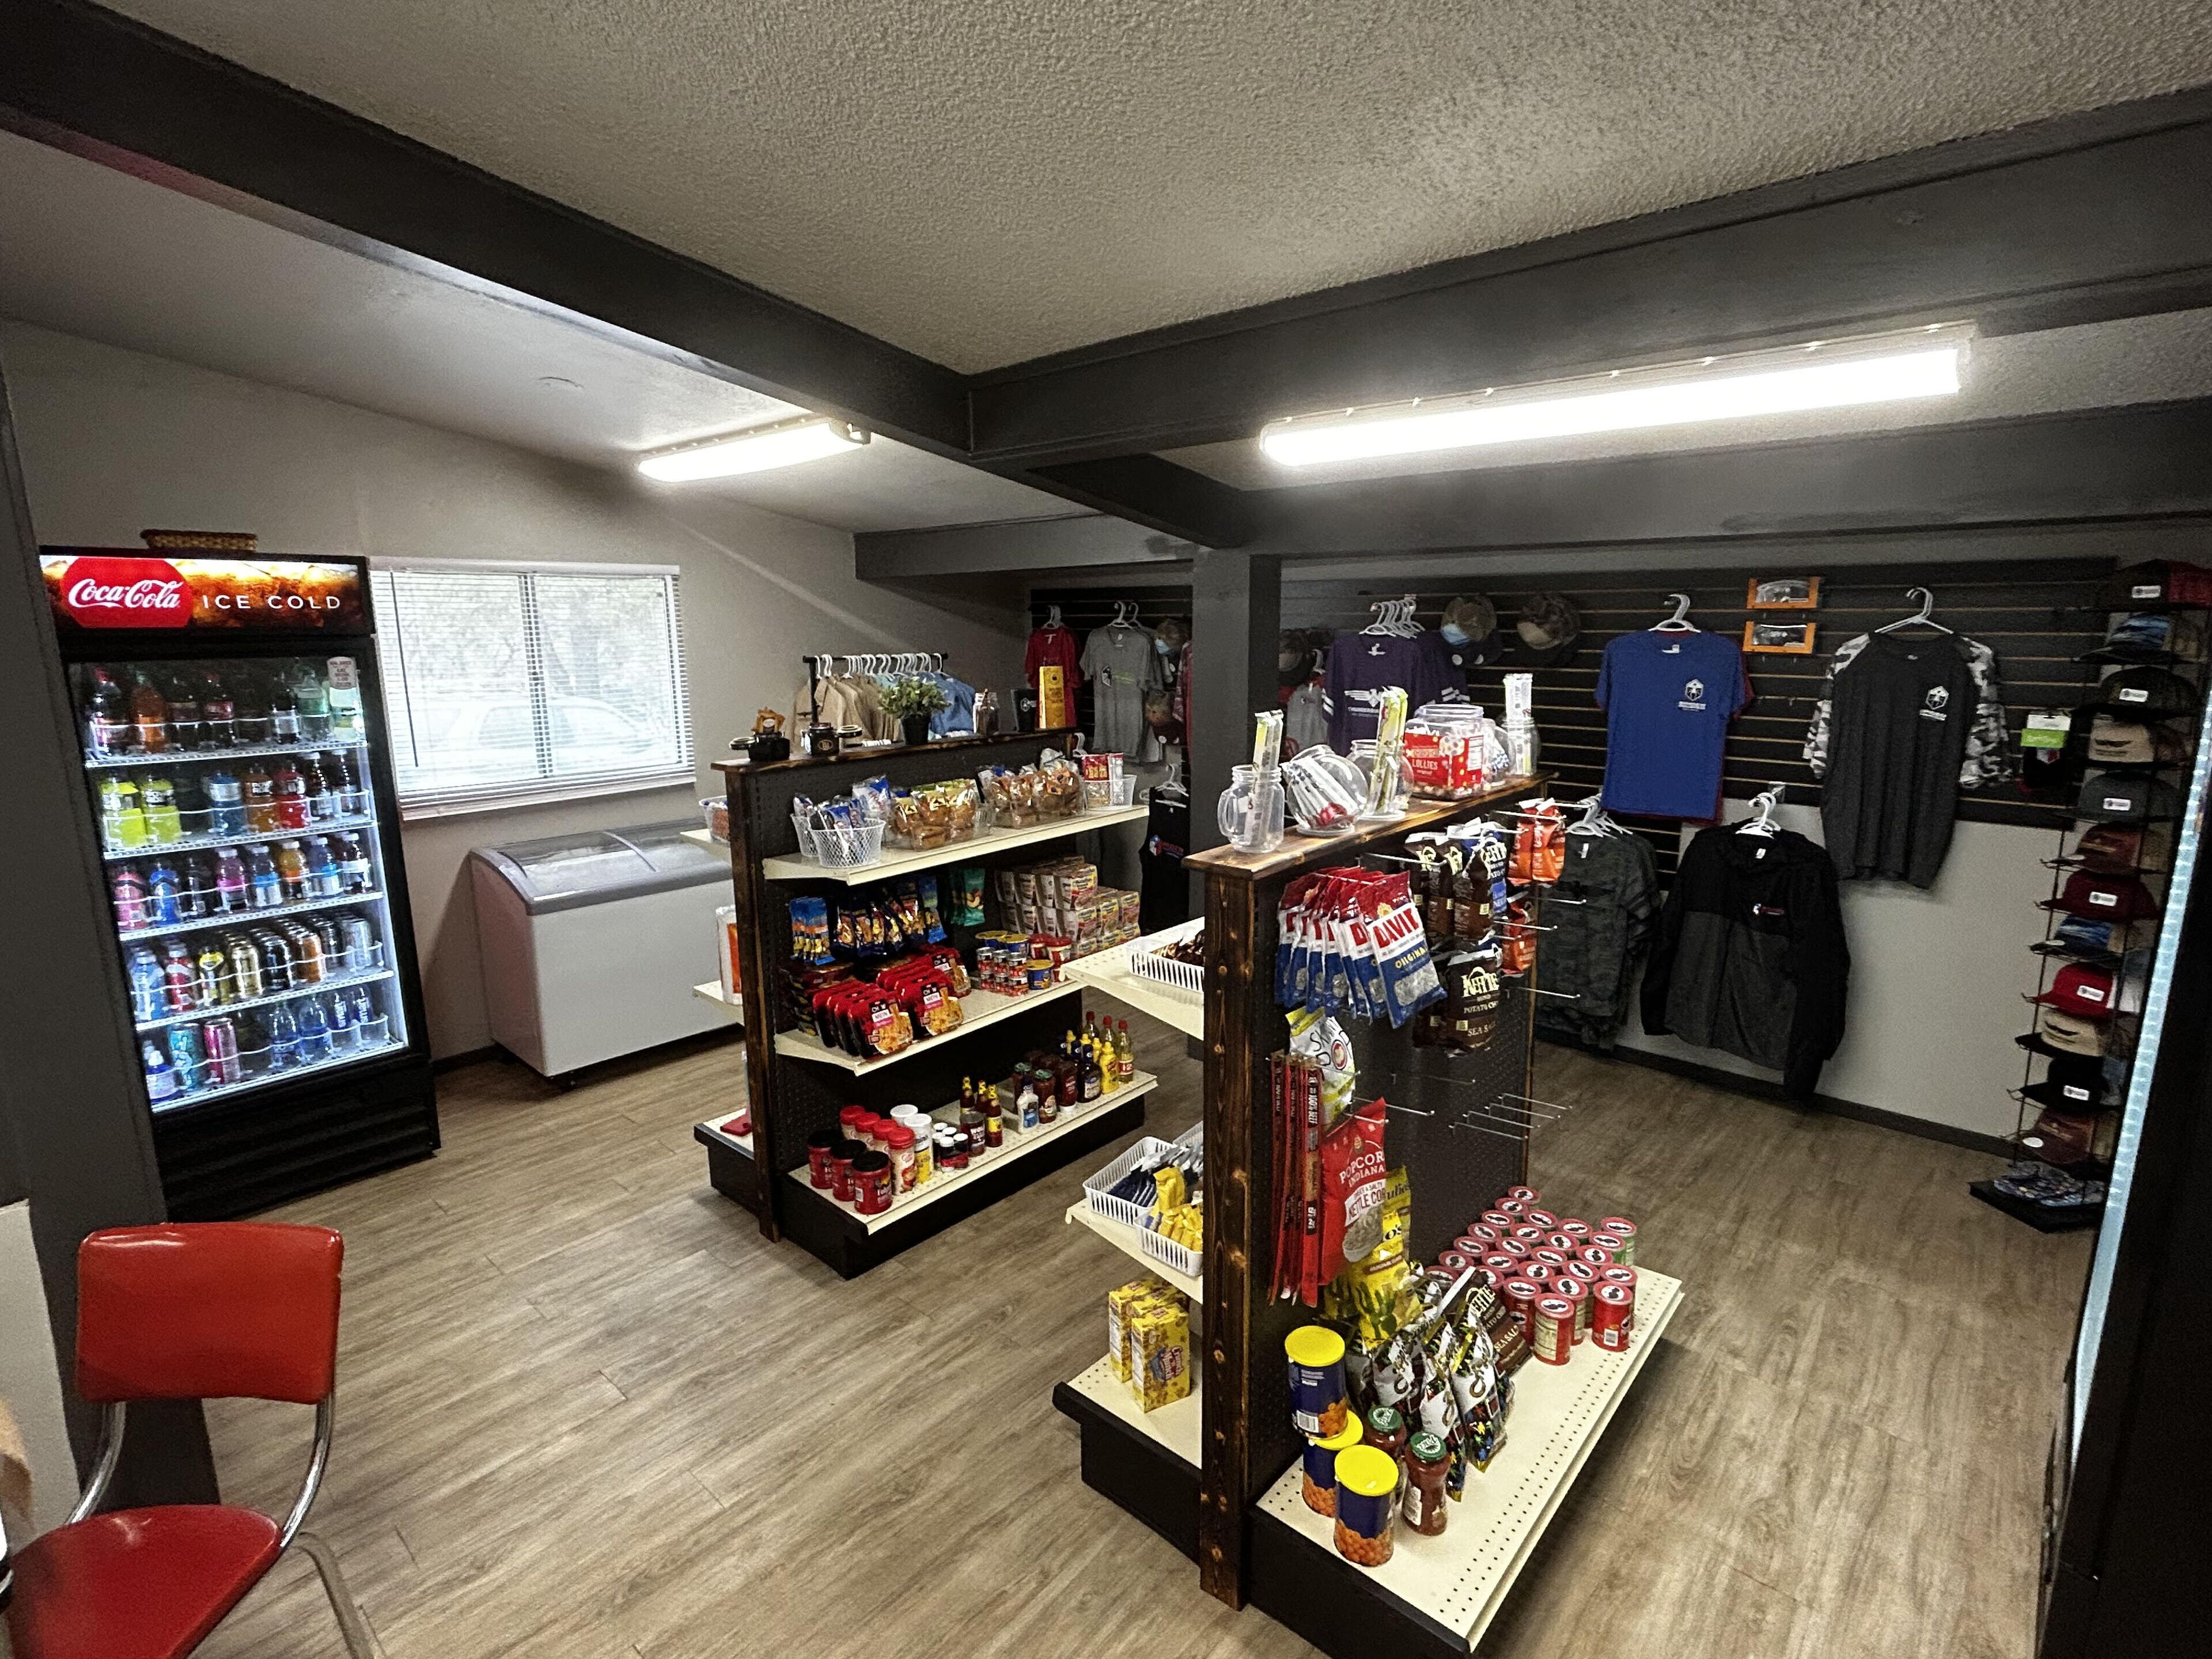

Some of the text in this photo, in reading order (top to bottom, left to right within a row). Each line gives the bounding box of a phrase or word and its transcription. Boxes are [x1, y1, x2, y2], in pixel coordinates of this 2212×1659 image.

[68, 578, 184, 608] Coca-Cola
[202, 594, 340, 609] ICE COLD
[1412, 757, 1438, 771] LOLLIES
[1395, 946, 1426, 969] ORIGINA
[1464, 1003, 1488, 1014] POTATO
[1339, 1151, 1385, 1184] POPCOR
[1349, 1164, 1385, 1188] INDIANA
[1494, 1335, 1509, 1353] SEA
